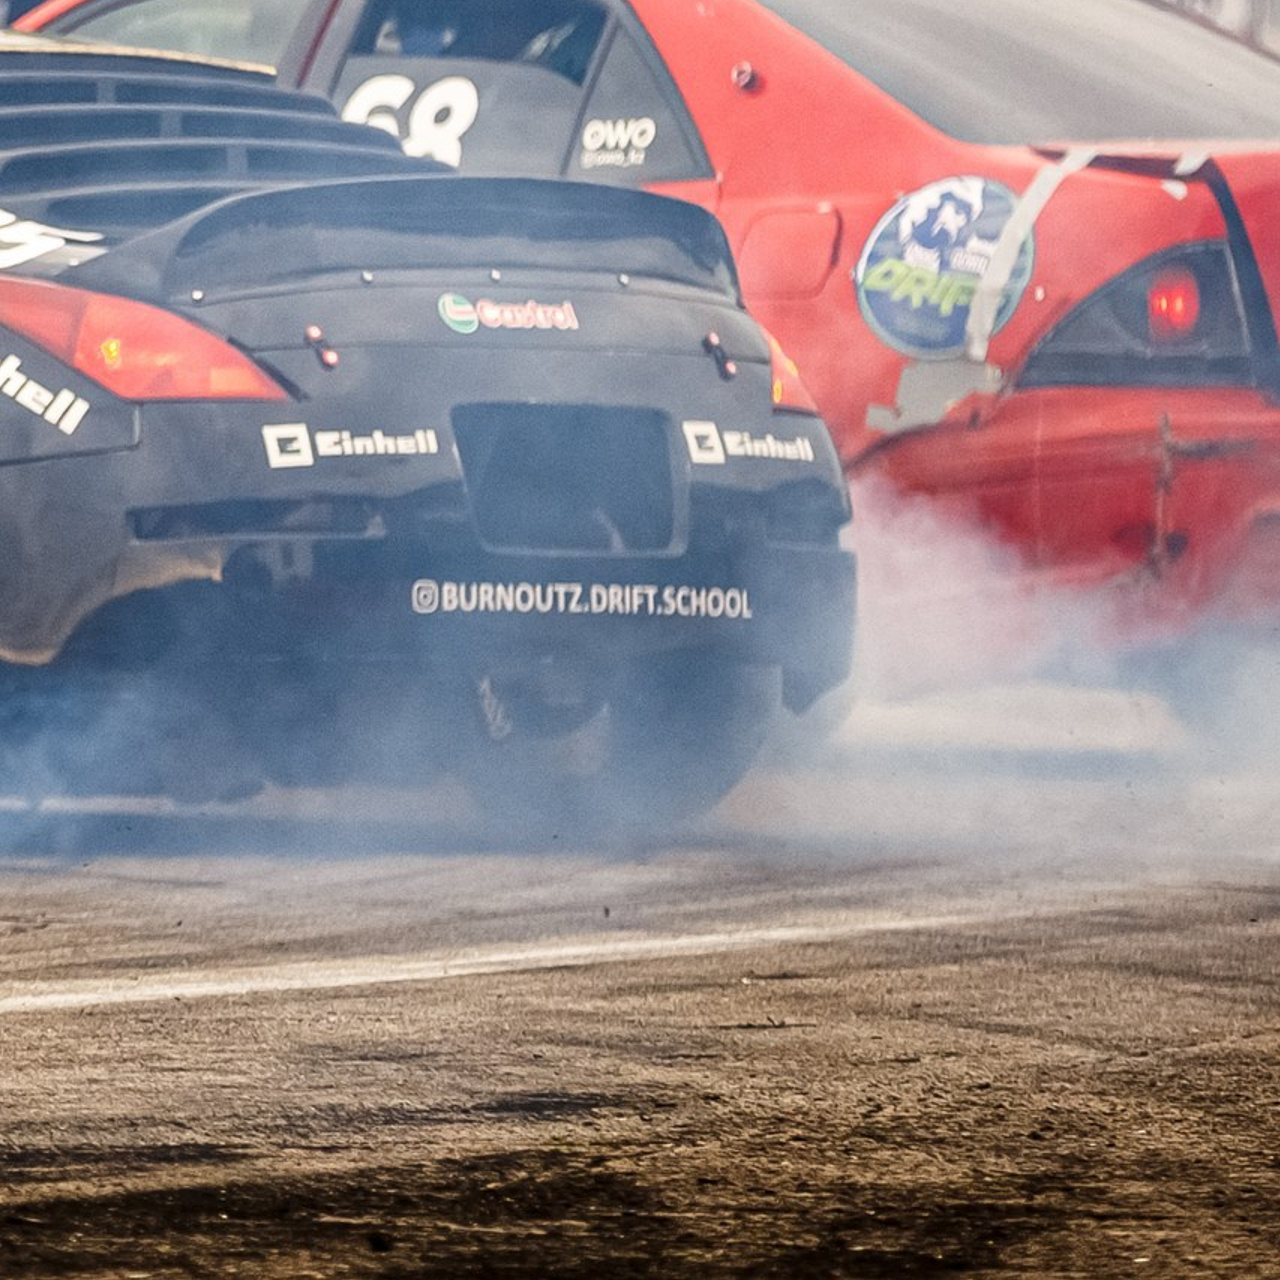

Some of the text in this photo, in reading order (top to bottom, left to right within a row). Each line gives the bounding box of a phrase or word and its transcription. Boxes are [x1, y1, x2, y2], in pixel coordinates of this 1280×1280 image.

[863, 257, 979, 318] DRIF
[477, 298, 579, 330] Castrol
[314, 428, 439, 458] Einhell
[722, 430, 815, 463] Einhell
